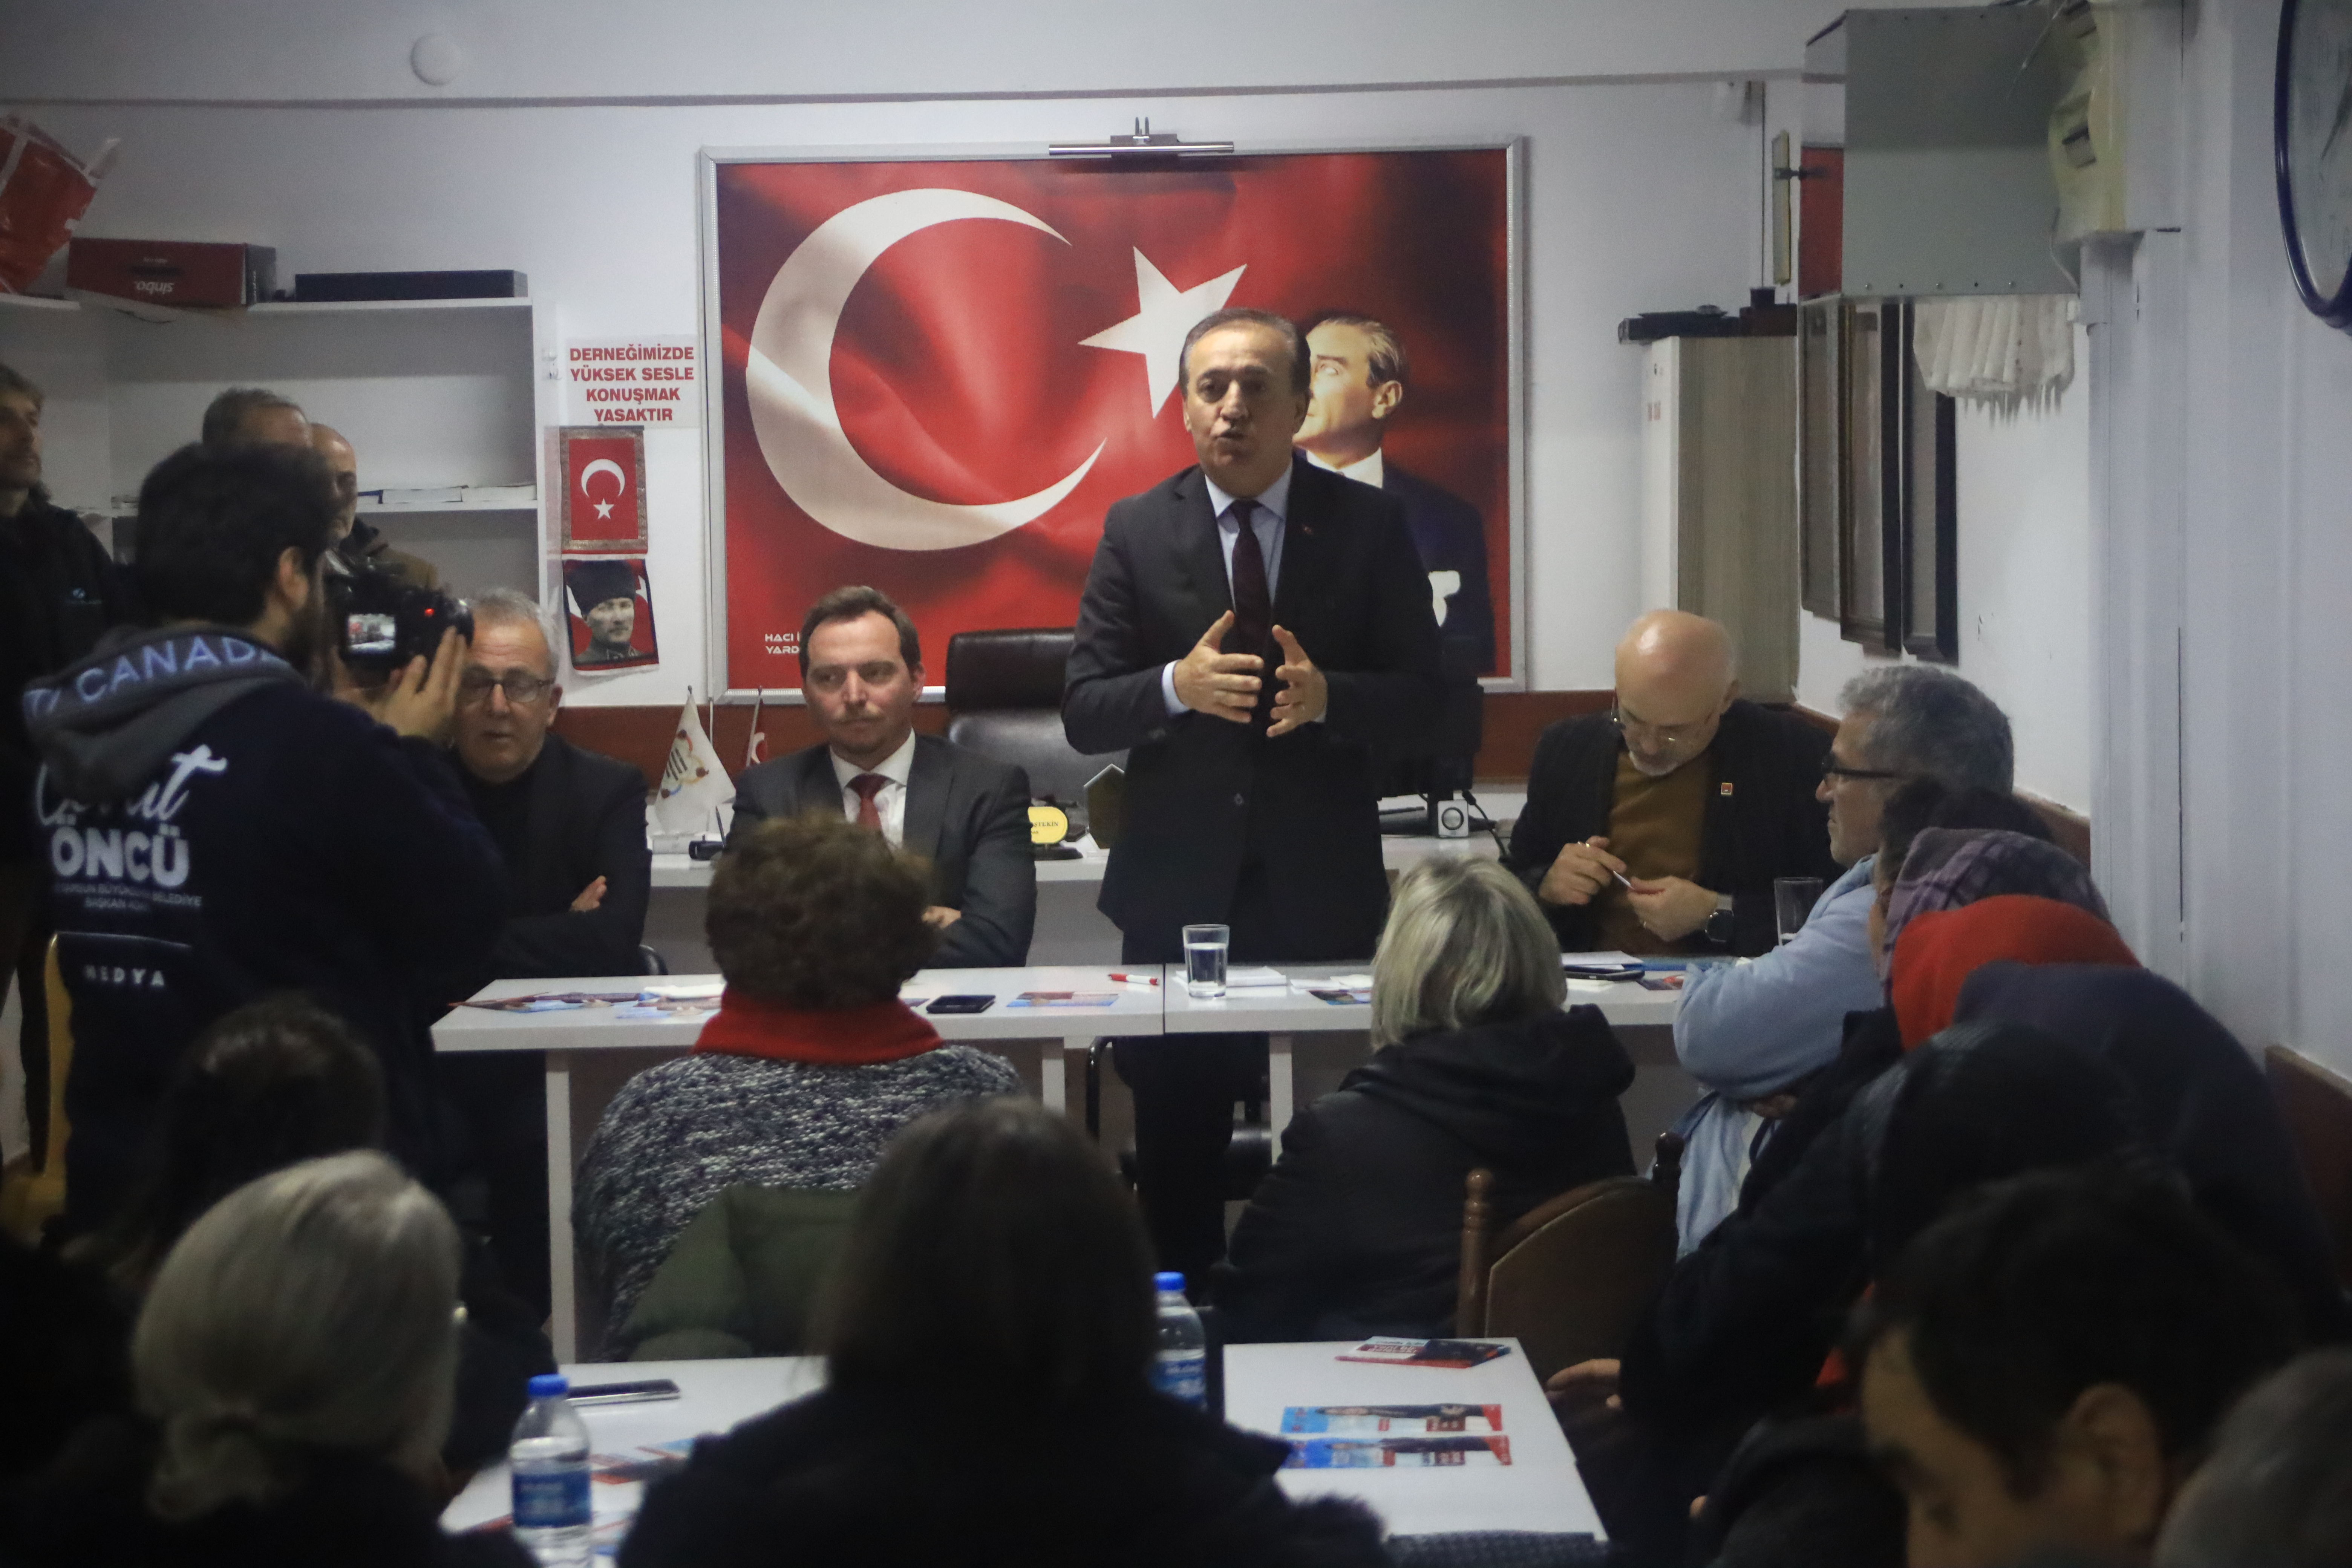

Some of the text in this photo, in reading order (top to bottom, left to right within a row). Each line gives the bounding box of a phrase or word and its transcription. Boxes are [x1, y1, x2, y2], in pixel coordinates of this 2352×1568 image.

[570, 343, 694, 361] DERNEĞİMİZDE
[570, 364, 694, 381] YÜKSEK SESLE
[586, 387, 681, 404] KONUŞMAK
[594, 408, 673, 422] YASAKTIR
[765, 633, 794, 642] HACI
[765, 646, 799, 654] YARD
